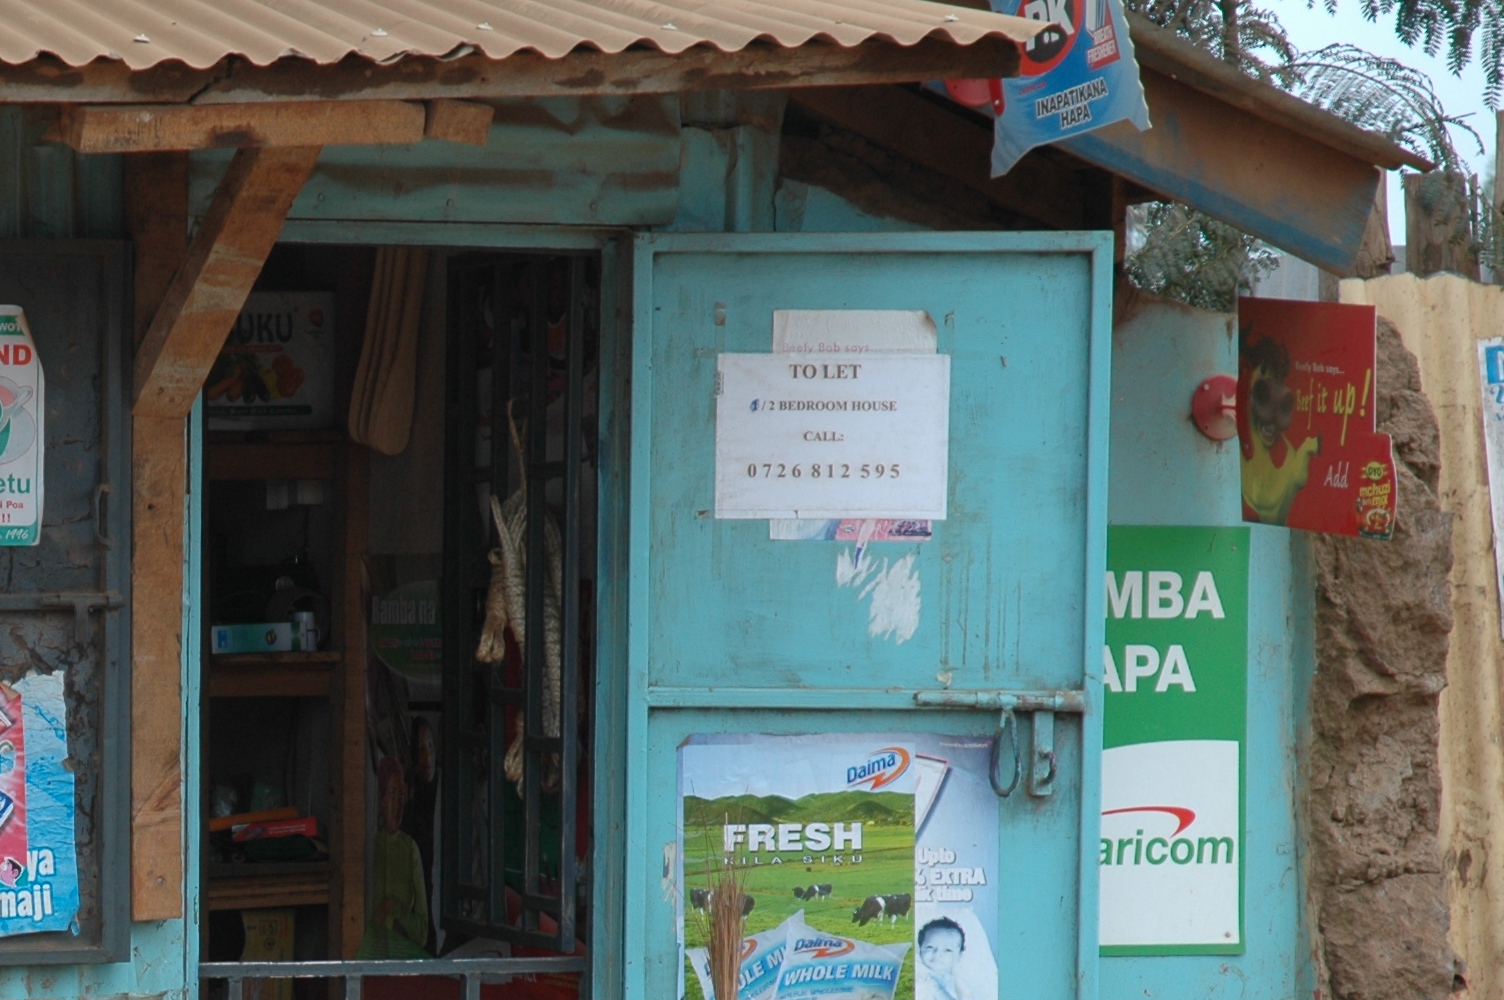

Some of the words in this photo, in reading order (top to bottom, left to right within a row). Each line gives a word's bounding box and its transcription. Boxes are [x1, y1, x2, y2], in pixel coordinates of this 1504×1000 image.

[1037, 78, 1107, 118] INAPATIKANA
[1061, 106, 1090, 128] HAPA
[818, 342, 841, 352] Bob
[789, 364, 817, 379] TO
[822, 364, 861, 379] LET
[769, 401, 775, 411] 2
[779, 400, 847, 411] BEDROOM
[851, 400, 897, 411] HOUSE
[1317, 383, 1328, 413] it
[1333, 368, 1371, 446] up!
[804, 431, 844, 442] CALL:
[1324, 461, 1349, 488] Add
[1106, 570, 1225, 619] MBA
[847, 753, 896, 783] Daima
[724, 822, 863, 852] FRESH
[26, 850, 54, 882] ya
[725, 856, 783, 865] KILA
[803, 855, 863, 864] SIKU
[916, 849, 955, 866] Upto
[935, 868, 986, 886] EXTRA
[937, 888, 973, 902] time
[794, 938, 843, 951] Daima
[785, 965, 848, 986] WHOLE
[852, 964, 894, 980] MILK
